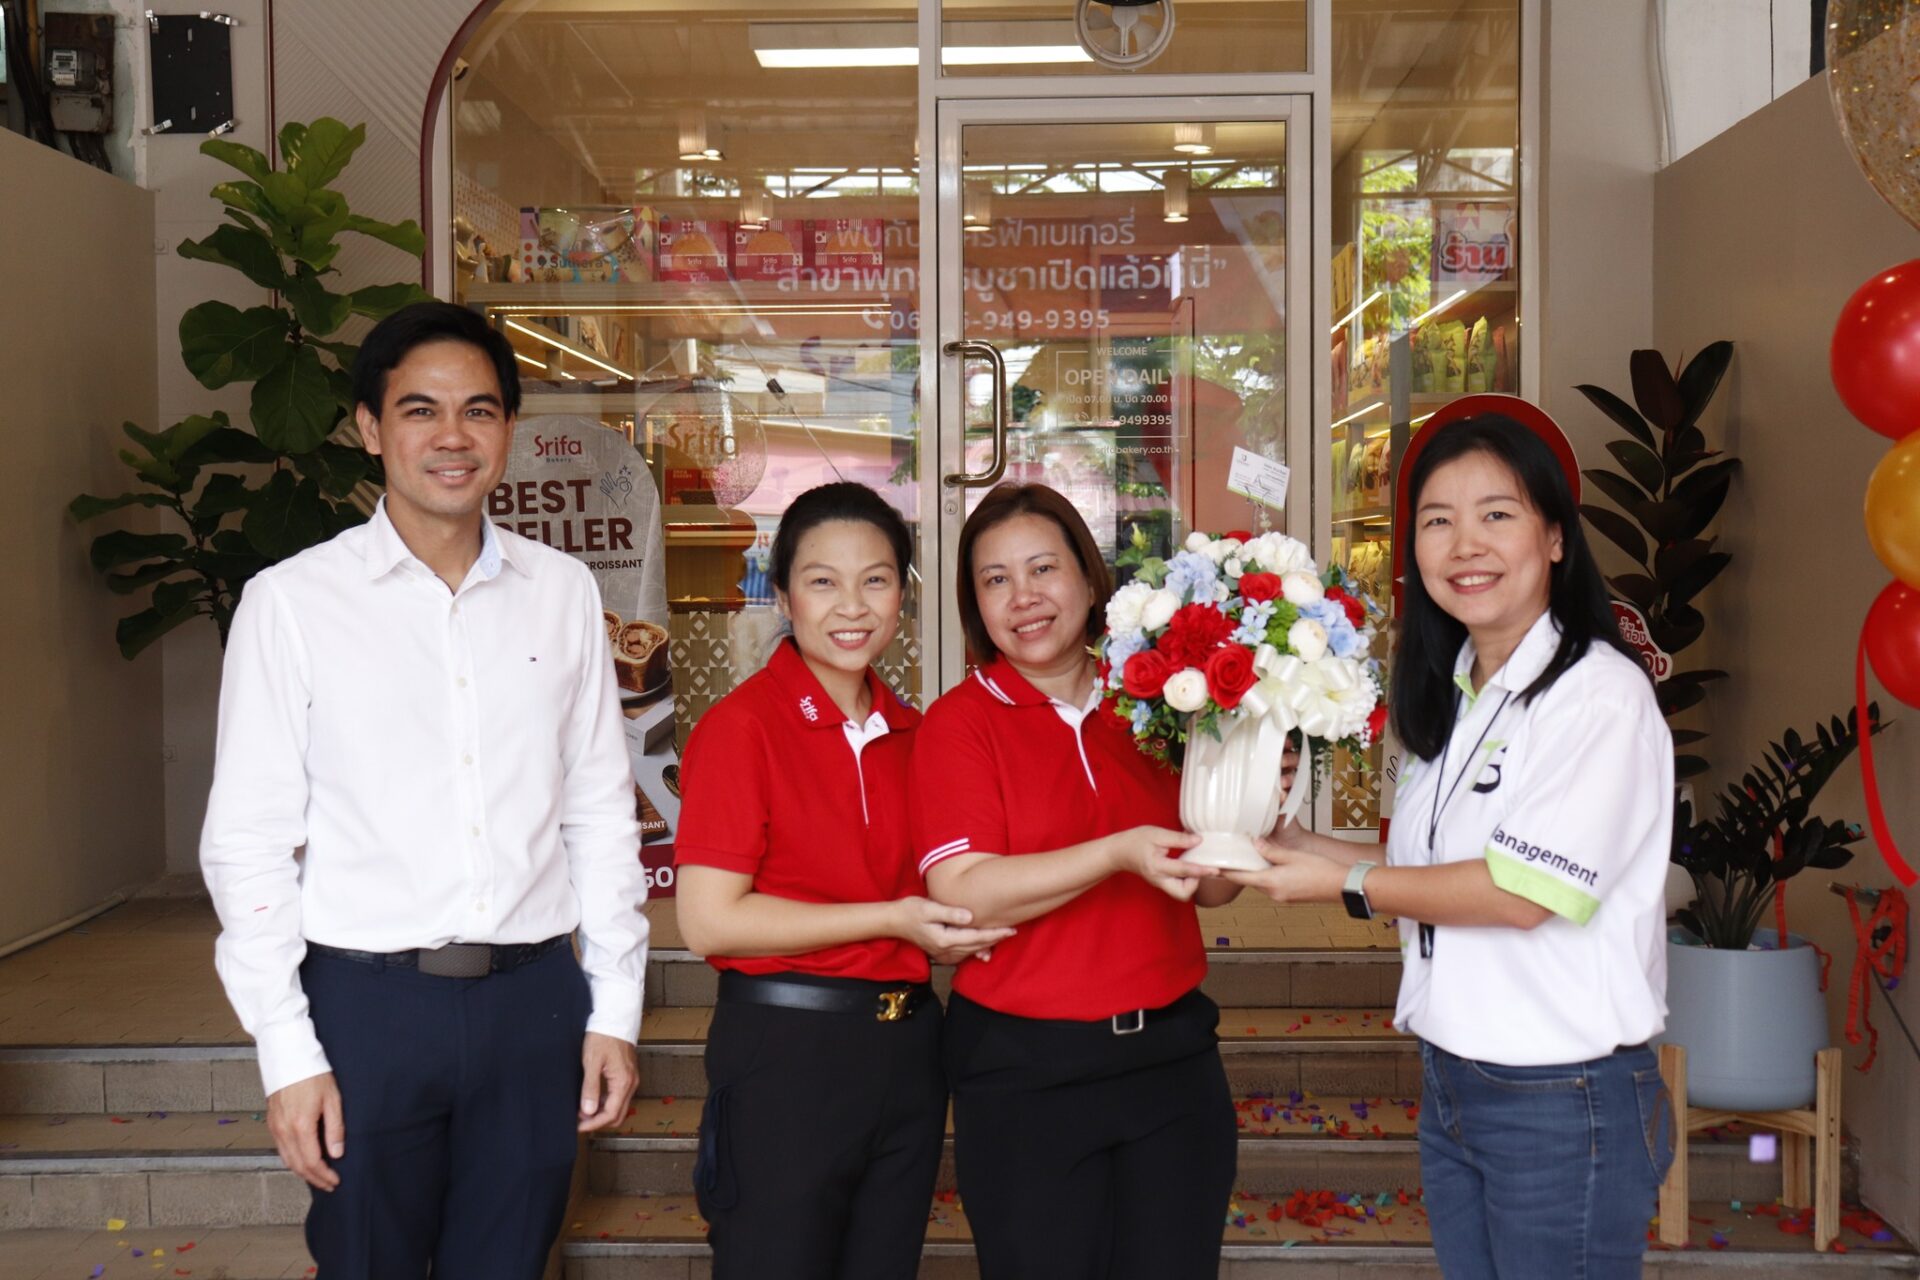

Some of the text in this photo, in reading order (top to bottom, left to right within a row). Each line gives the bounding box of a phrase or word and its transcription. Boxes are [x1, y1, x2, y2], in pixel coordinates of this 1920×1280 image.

[1096, 346, 1149, 357] WELCOME
[1140, 395, 1168, 404] 20.00
[533, 434, 583, 457] Srifa
[488, 479, 592, 516] BEST
[640, 820, 666, 830] SANT
[1491, 823, 1599, 887] anagement
